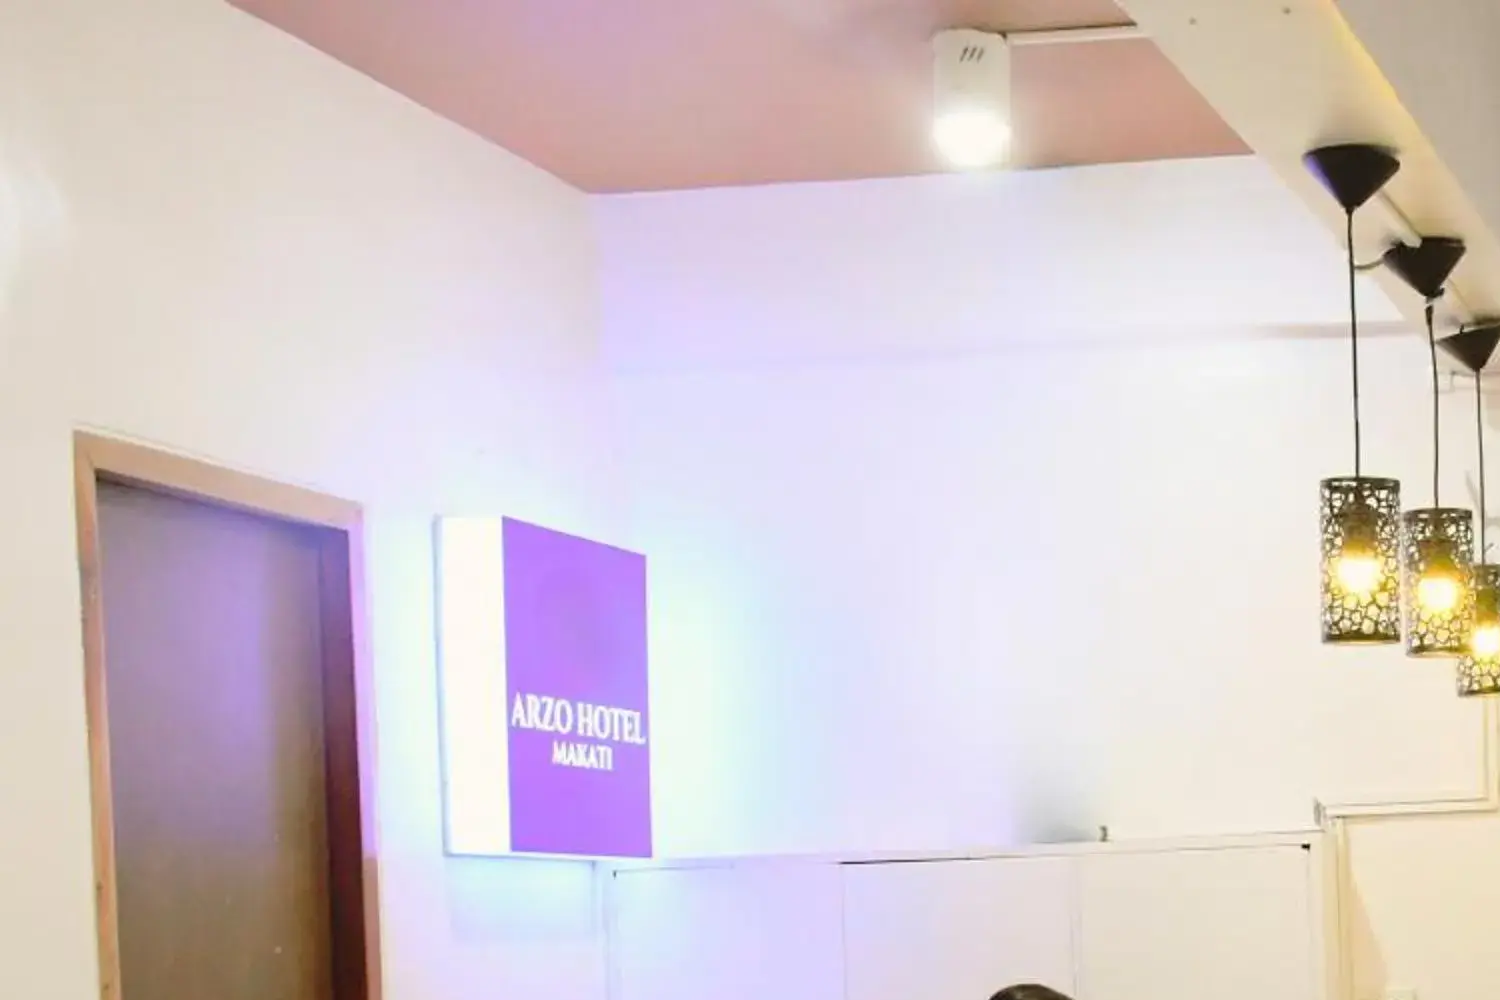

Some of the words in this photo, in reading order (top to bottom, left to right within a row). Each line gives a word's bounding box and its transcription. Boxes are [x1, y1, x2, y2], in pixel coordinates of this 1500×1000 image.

[511, 692, 573, 734] ARZO
[578, 703, 646, 744] HOTEL
[552, 740, 613, 770] MAKATI
